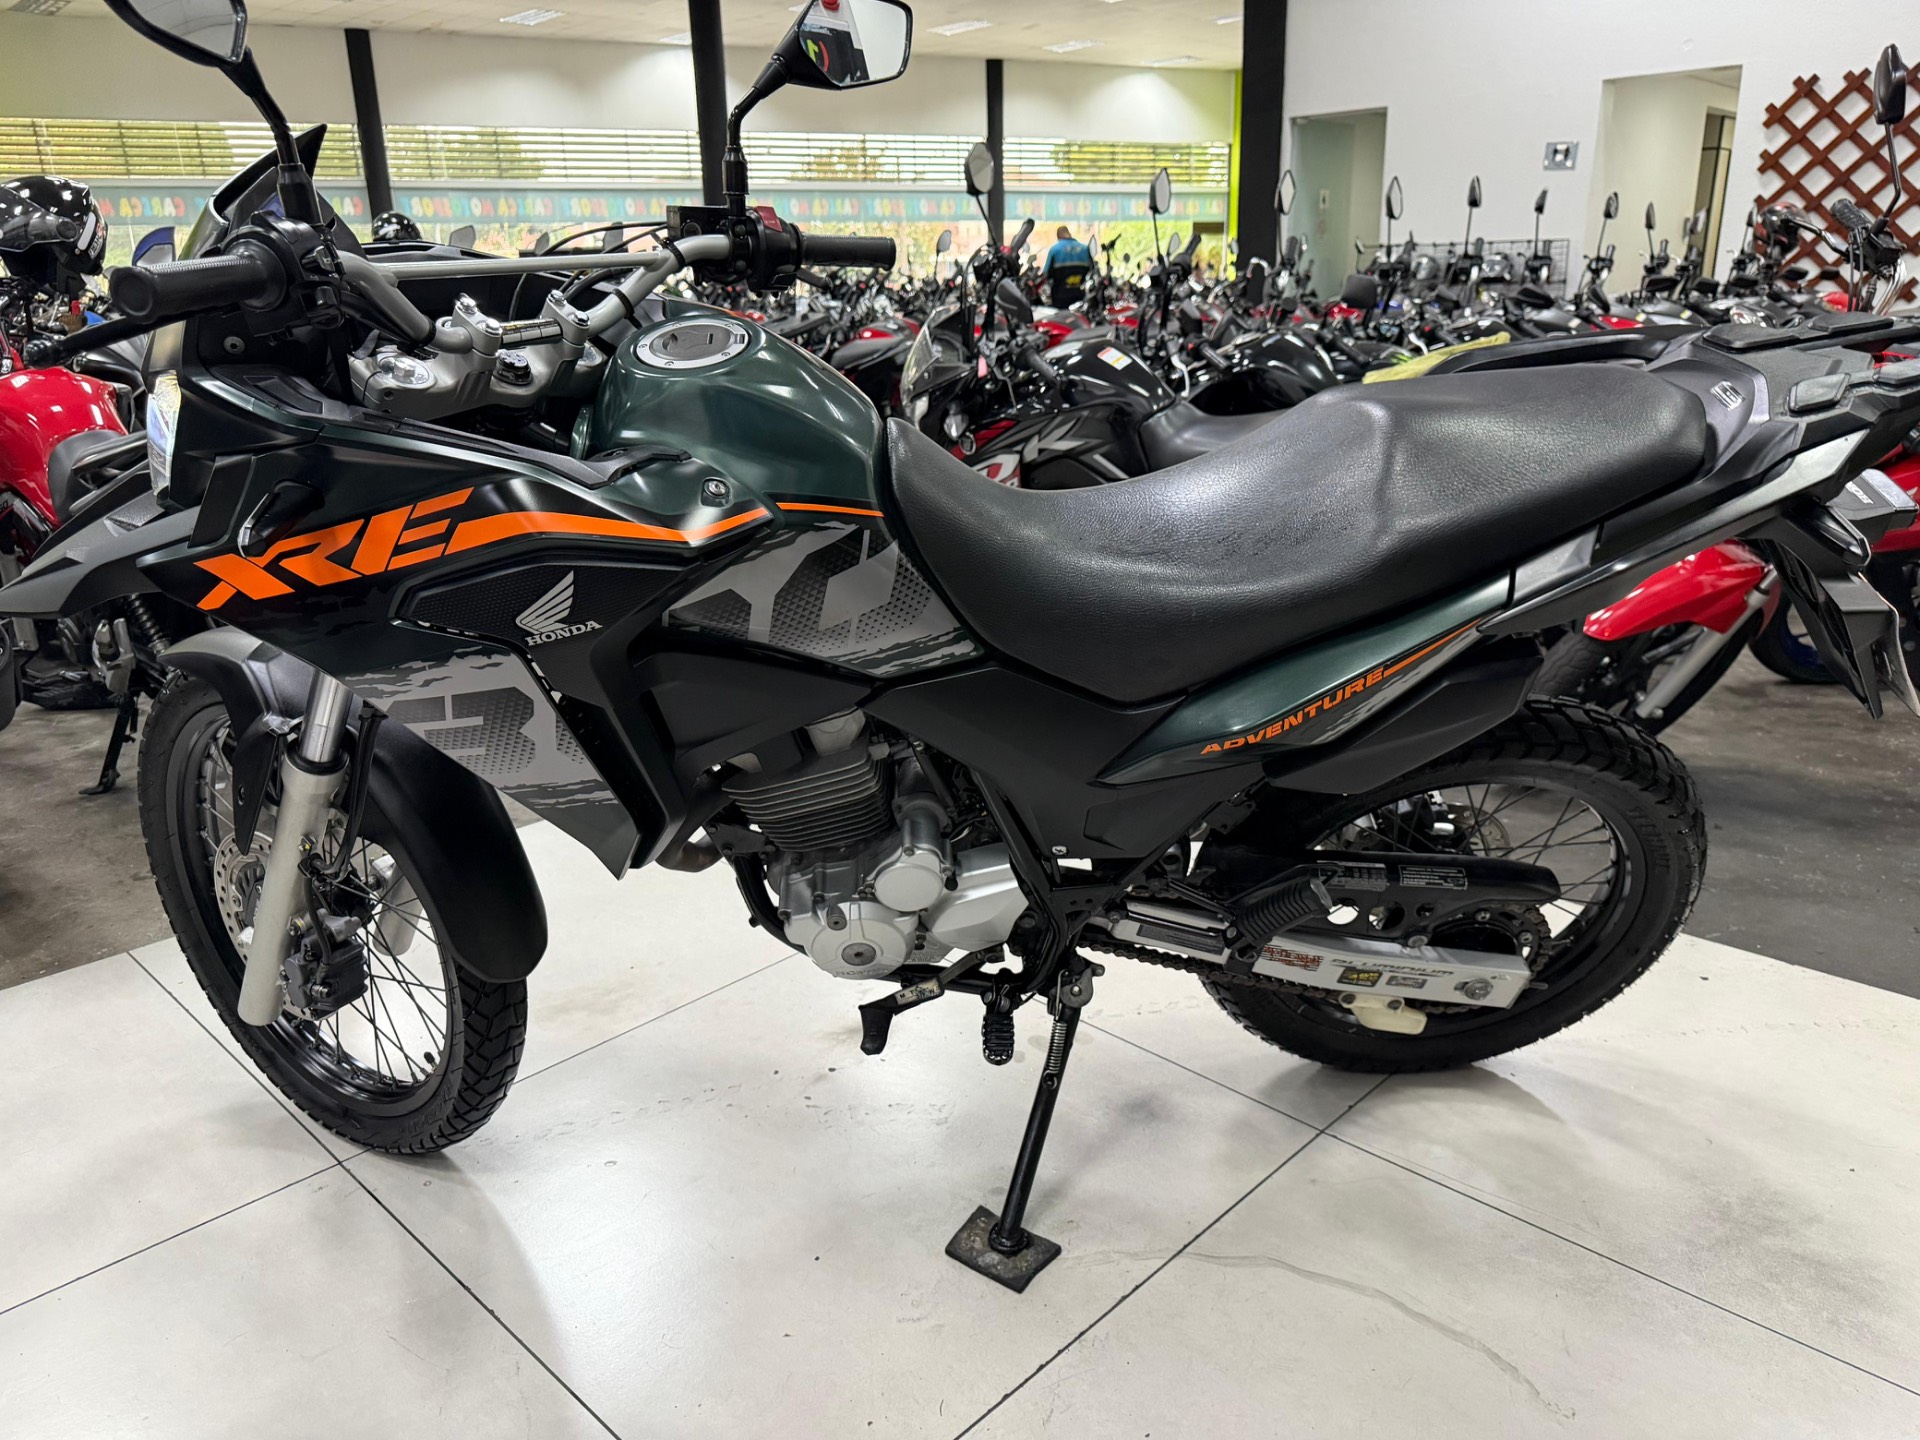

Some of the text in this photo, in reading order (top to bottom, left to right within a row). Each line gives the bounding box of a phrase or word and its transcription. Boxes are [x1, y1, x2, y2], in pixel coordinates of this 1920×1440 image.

[193, 487, 474, 610] XRE
[525, 620, 603, 646] HONDA
[1200, 666, 1384, 754] ADVENTURE
